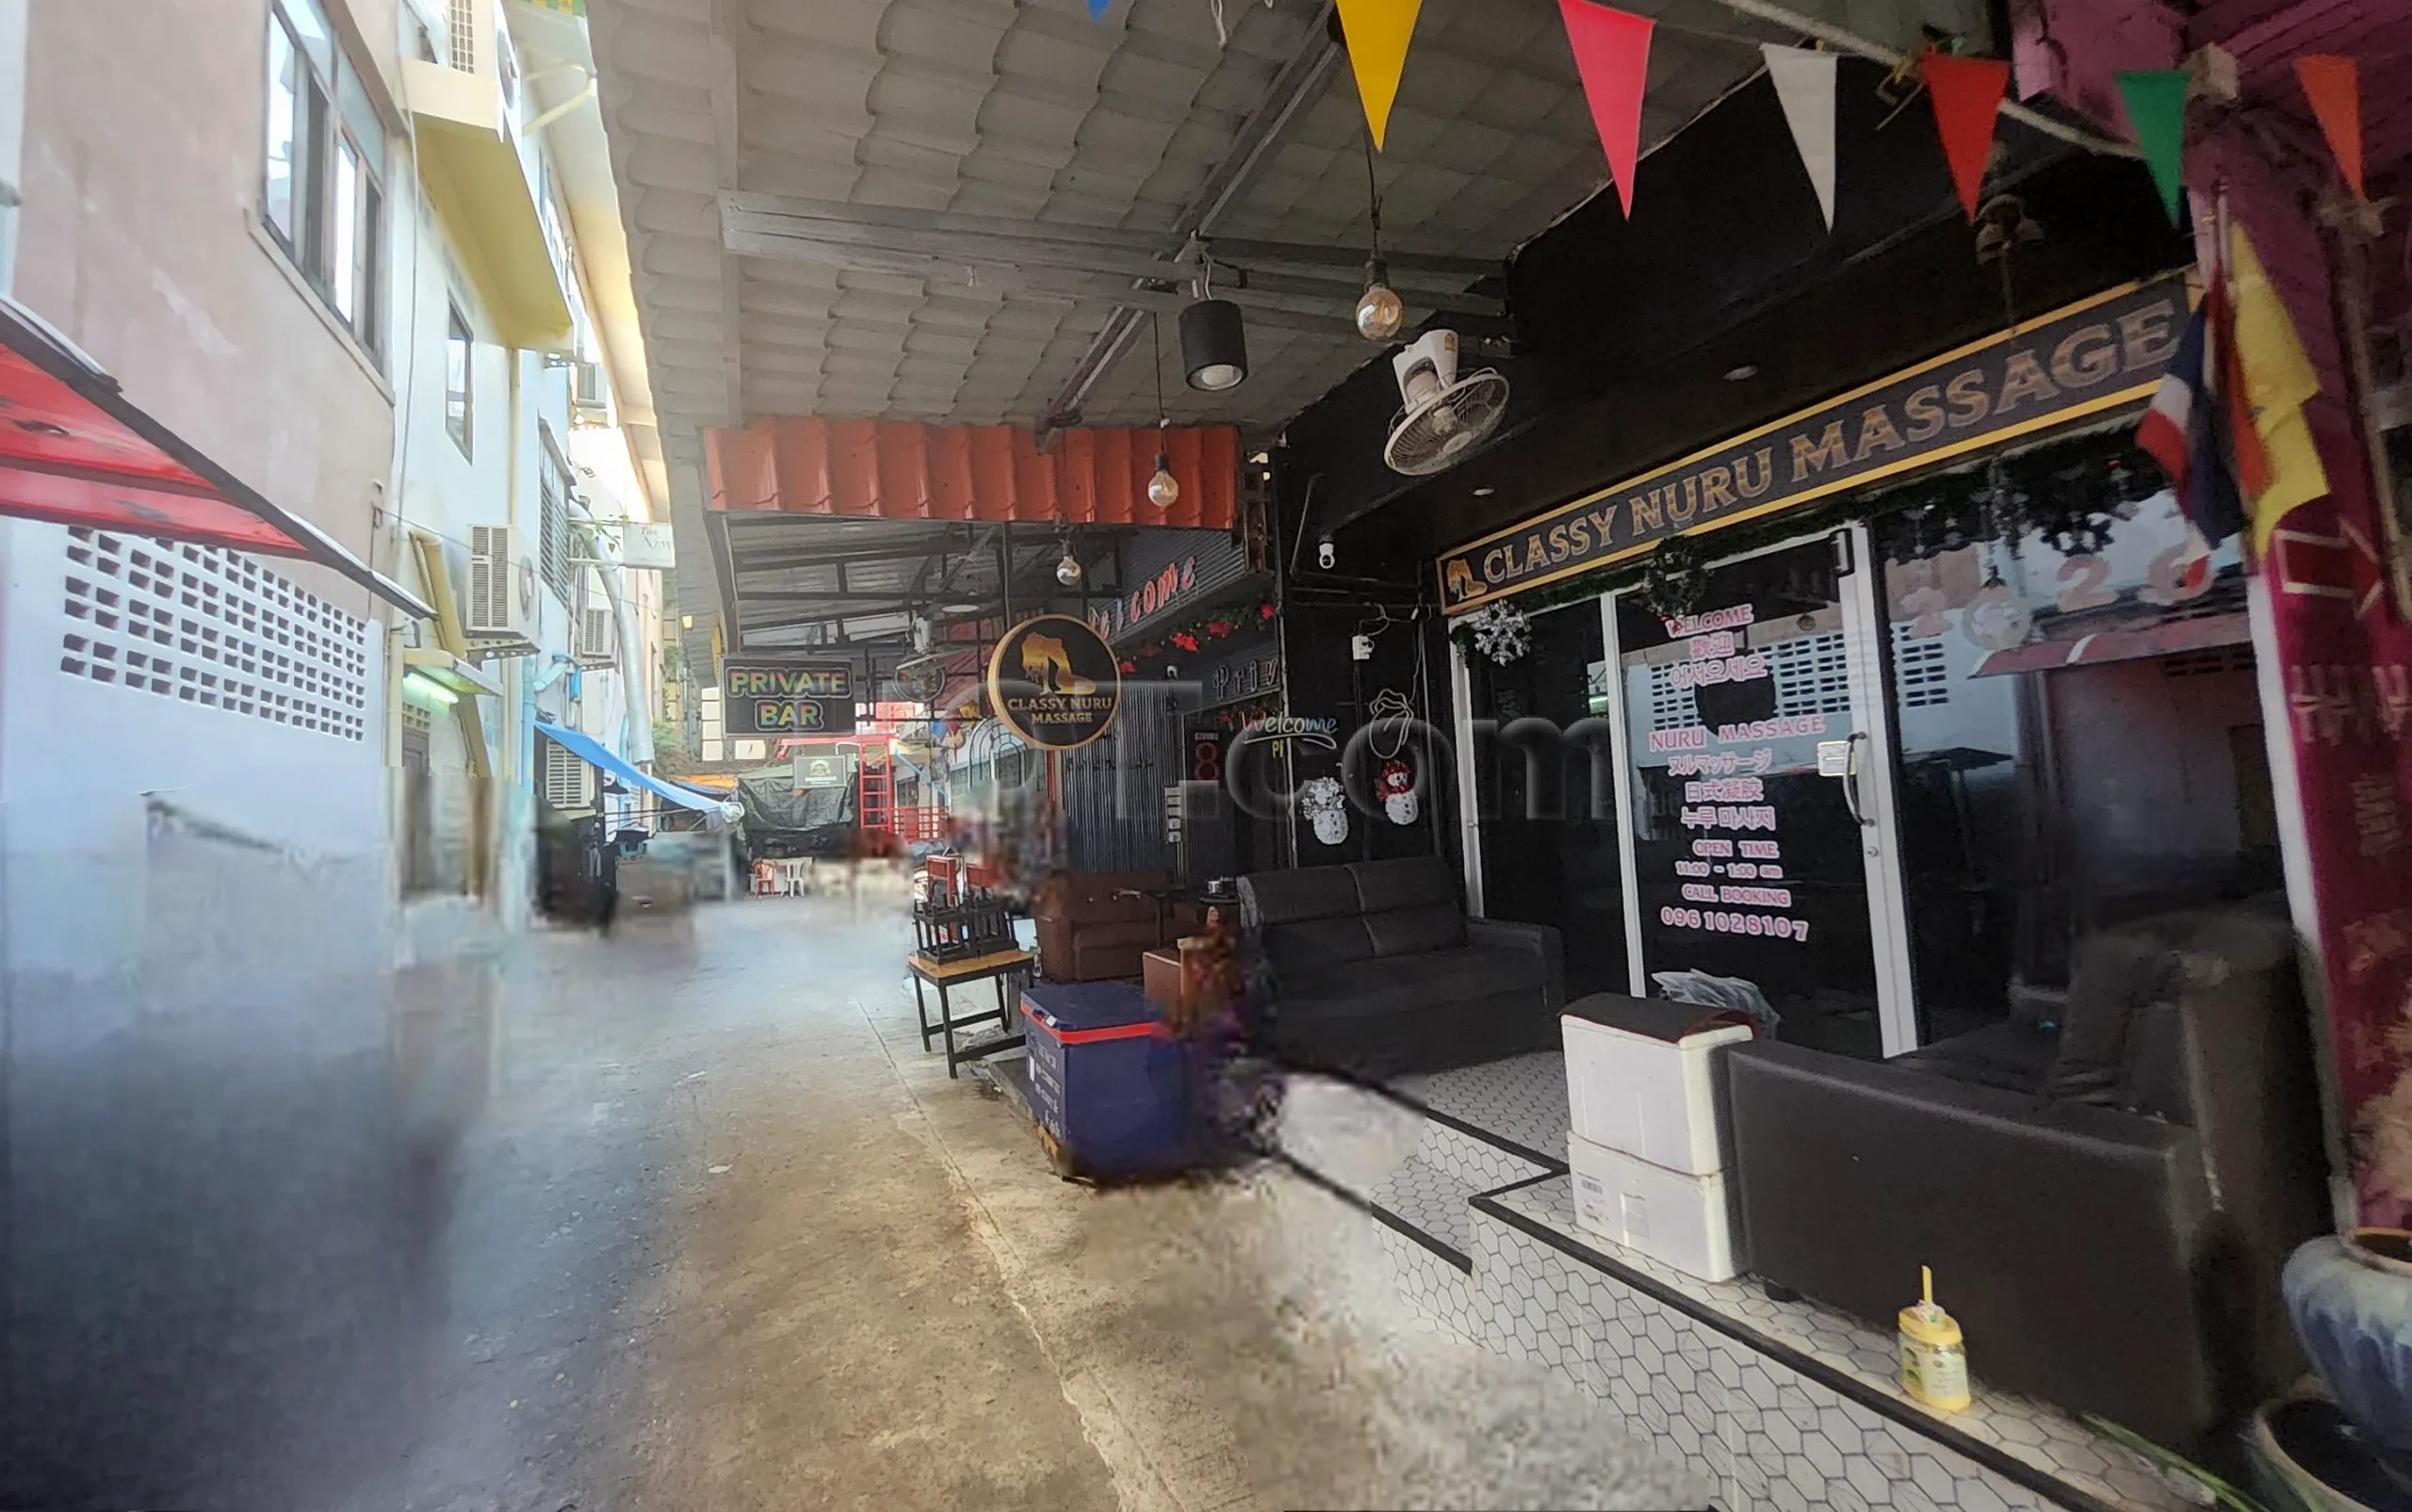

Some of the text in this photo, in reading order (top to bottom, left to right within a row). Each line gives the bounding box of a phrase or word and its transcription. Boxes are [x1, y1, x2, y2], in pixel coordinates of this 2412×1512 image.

[1483, 299, 2180, 584] CLASSY NURU MASSAGE
[1666, 604, 1752, 638] WELCOME
[730, 671, 846, 693] PRIVATE
[1670, 654, 1768, 689] 어서오세요
[760, 704, 818, 725] BAR
[1007, 696, 1113, 711] CLASSY NURU
[1031, 711, 1094, 724] MASSAGE
[1240, 710, 1338, 734] Welcome
[1650, 715, 1825, 751] NURU MASSAGE
[1669, 749, 1772, 775] ヌルマッサージ
[1693, 839, 1780, 858] OPEN TIME
[1675, 862, 1709, 877] 11:00
[1727, 863, 1757, 878] 1:00
[1759, 866, 1783, 878] am
[1682, 884, 1791, 907] CALL BOOKING
